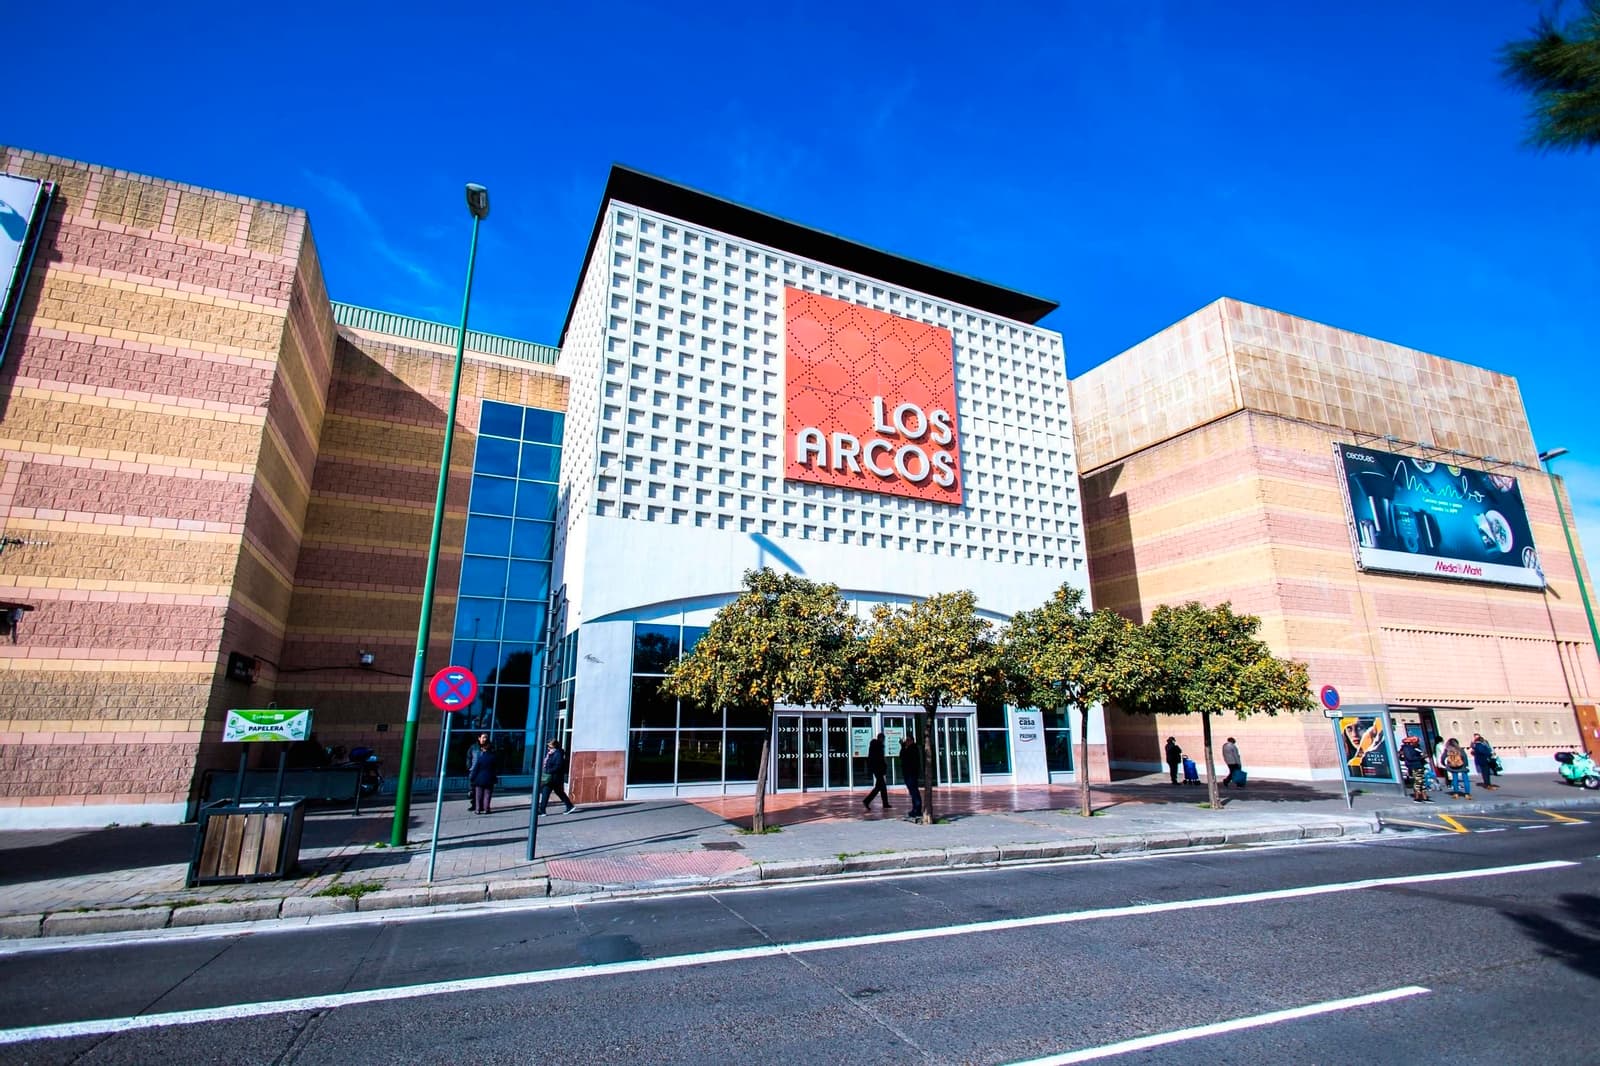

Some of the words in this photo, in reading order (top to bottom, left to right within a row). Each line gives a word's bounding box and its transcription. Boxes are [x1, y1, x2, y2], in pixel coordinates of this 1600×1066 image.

[872, 395, 953, 446] LOS
[797, 427, 955, 487] ARCOS
[1345, 451, 1375, 463] cecotec
